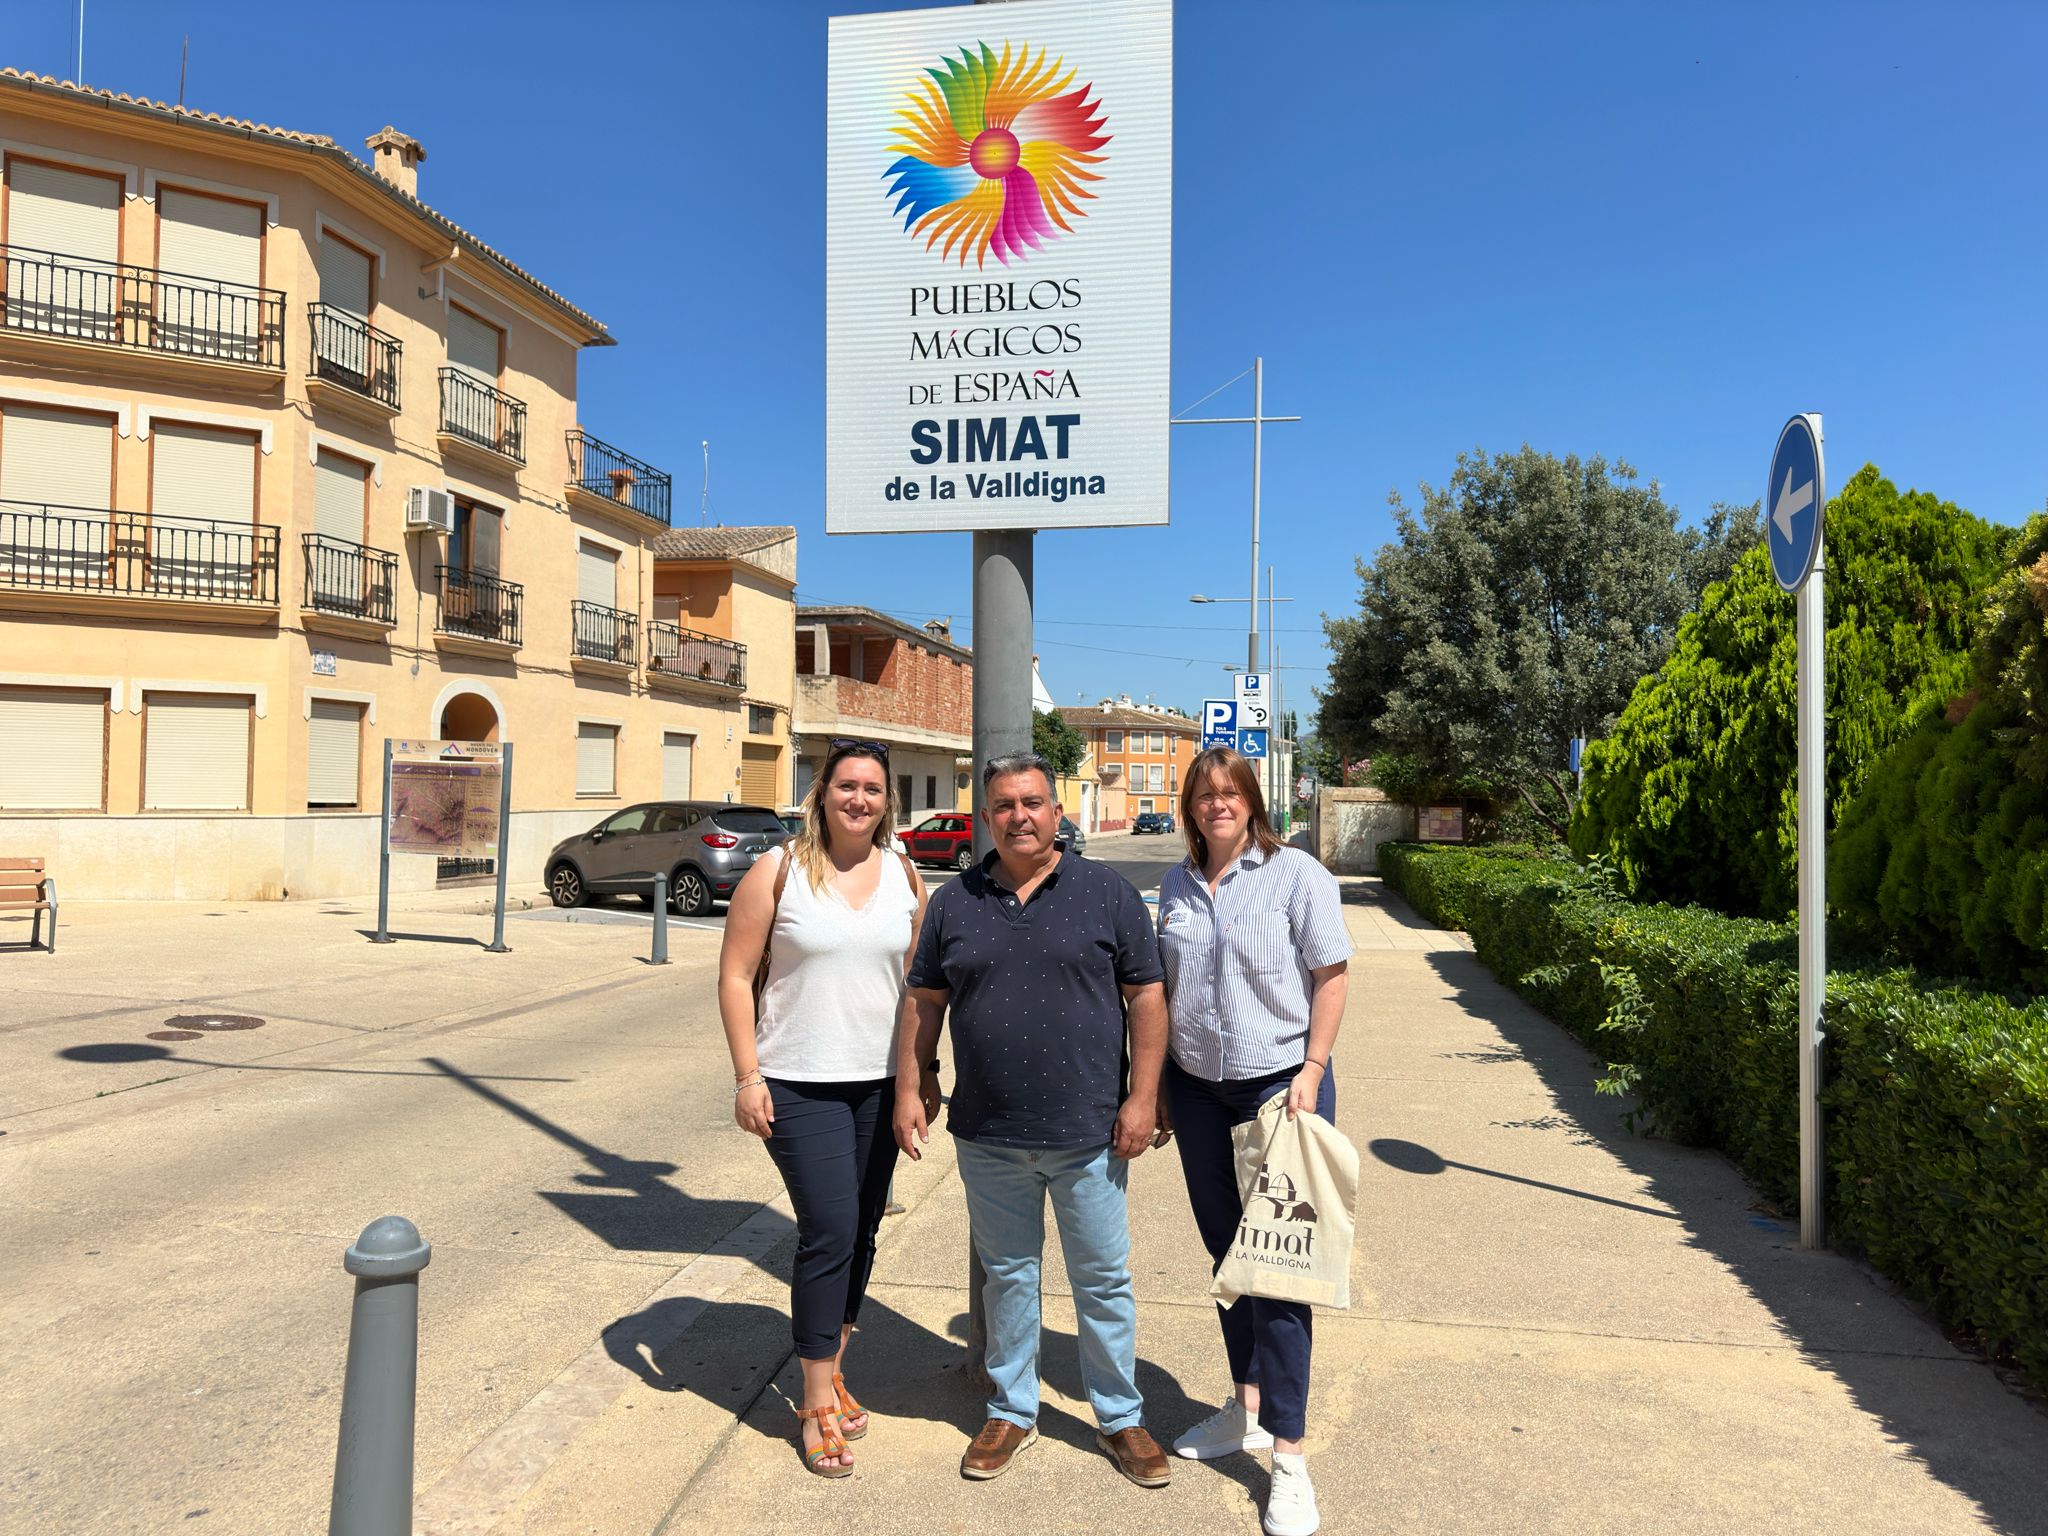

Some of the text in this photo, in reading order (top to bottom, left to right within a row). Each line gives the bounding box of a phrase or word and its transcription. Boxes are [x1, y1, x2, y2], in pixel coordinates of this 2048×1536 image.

[909, 278, 1082, 317] PUEBLOS
[909, 323, 1083, 361] MÁGICOS
[908, 368, 1082, 405] DE ESPAÑA
[909, 413, 1081, 465] SIMAT
[884, 471, 1106, 503] de la Valldigna
[1248, 677, 1256, 687] P
[1206, 703, 1232, 734] P
[1239, 1217, 1315, 1257] imat
[1235, 1250, 1248, 1260] LA
[1252, 1253, 1311, 1270] VALLDIGNA
